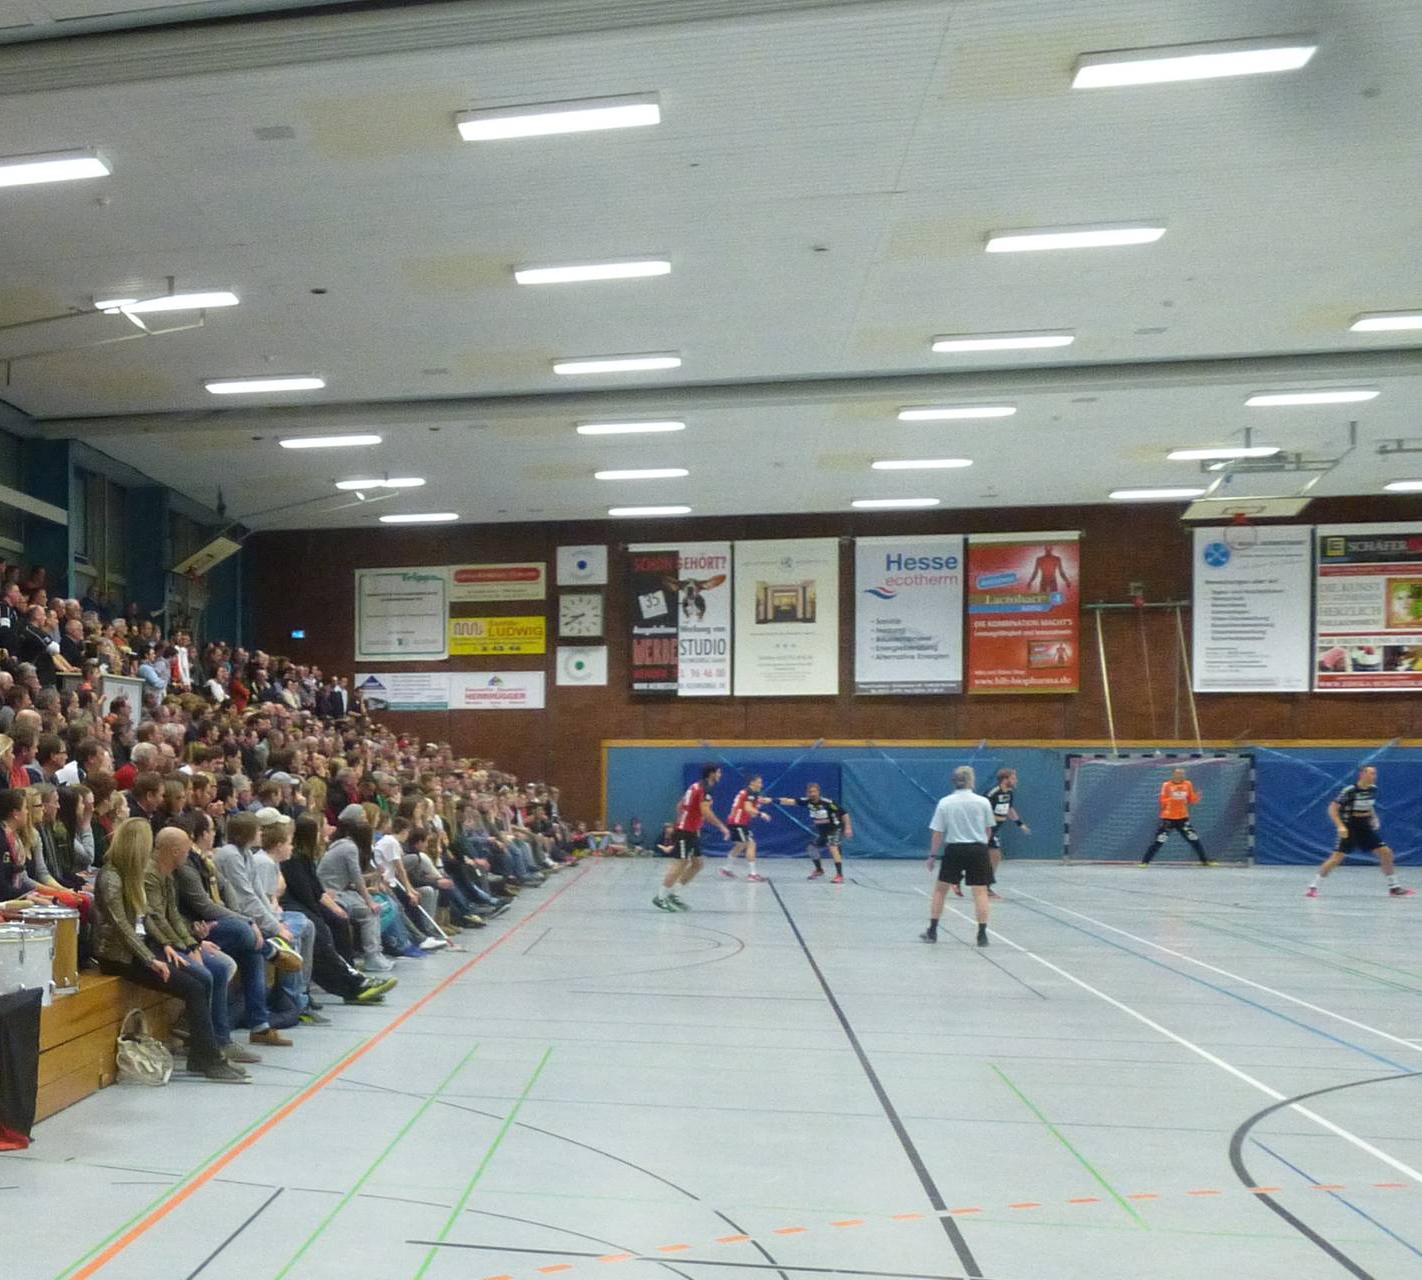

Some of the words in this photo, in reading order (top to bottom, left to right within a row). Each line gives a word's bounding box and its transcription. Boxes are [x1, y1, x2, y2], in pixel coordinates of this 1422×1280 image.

[1348, 539, 1409, 552] SCHÄFER
[676, 552, 727, 570] GEHÖRT?
[885, 553, 958, 571] Hesse
[885, 573, 959, 587] ecotherm
[489, 626, 543, 637] LUDWIG
